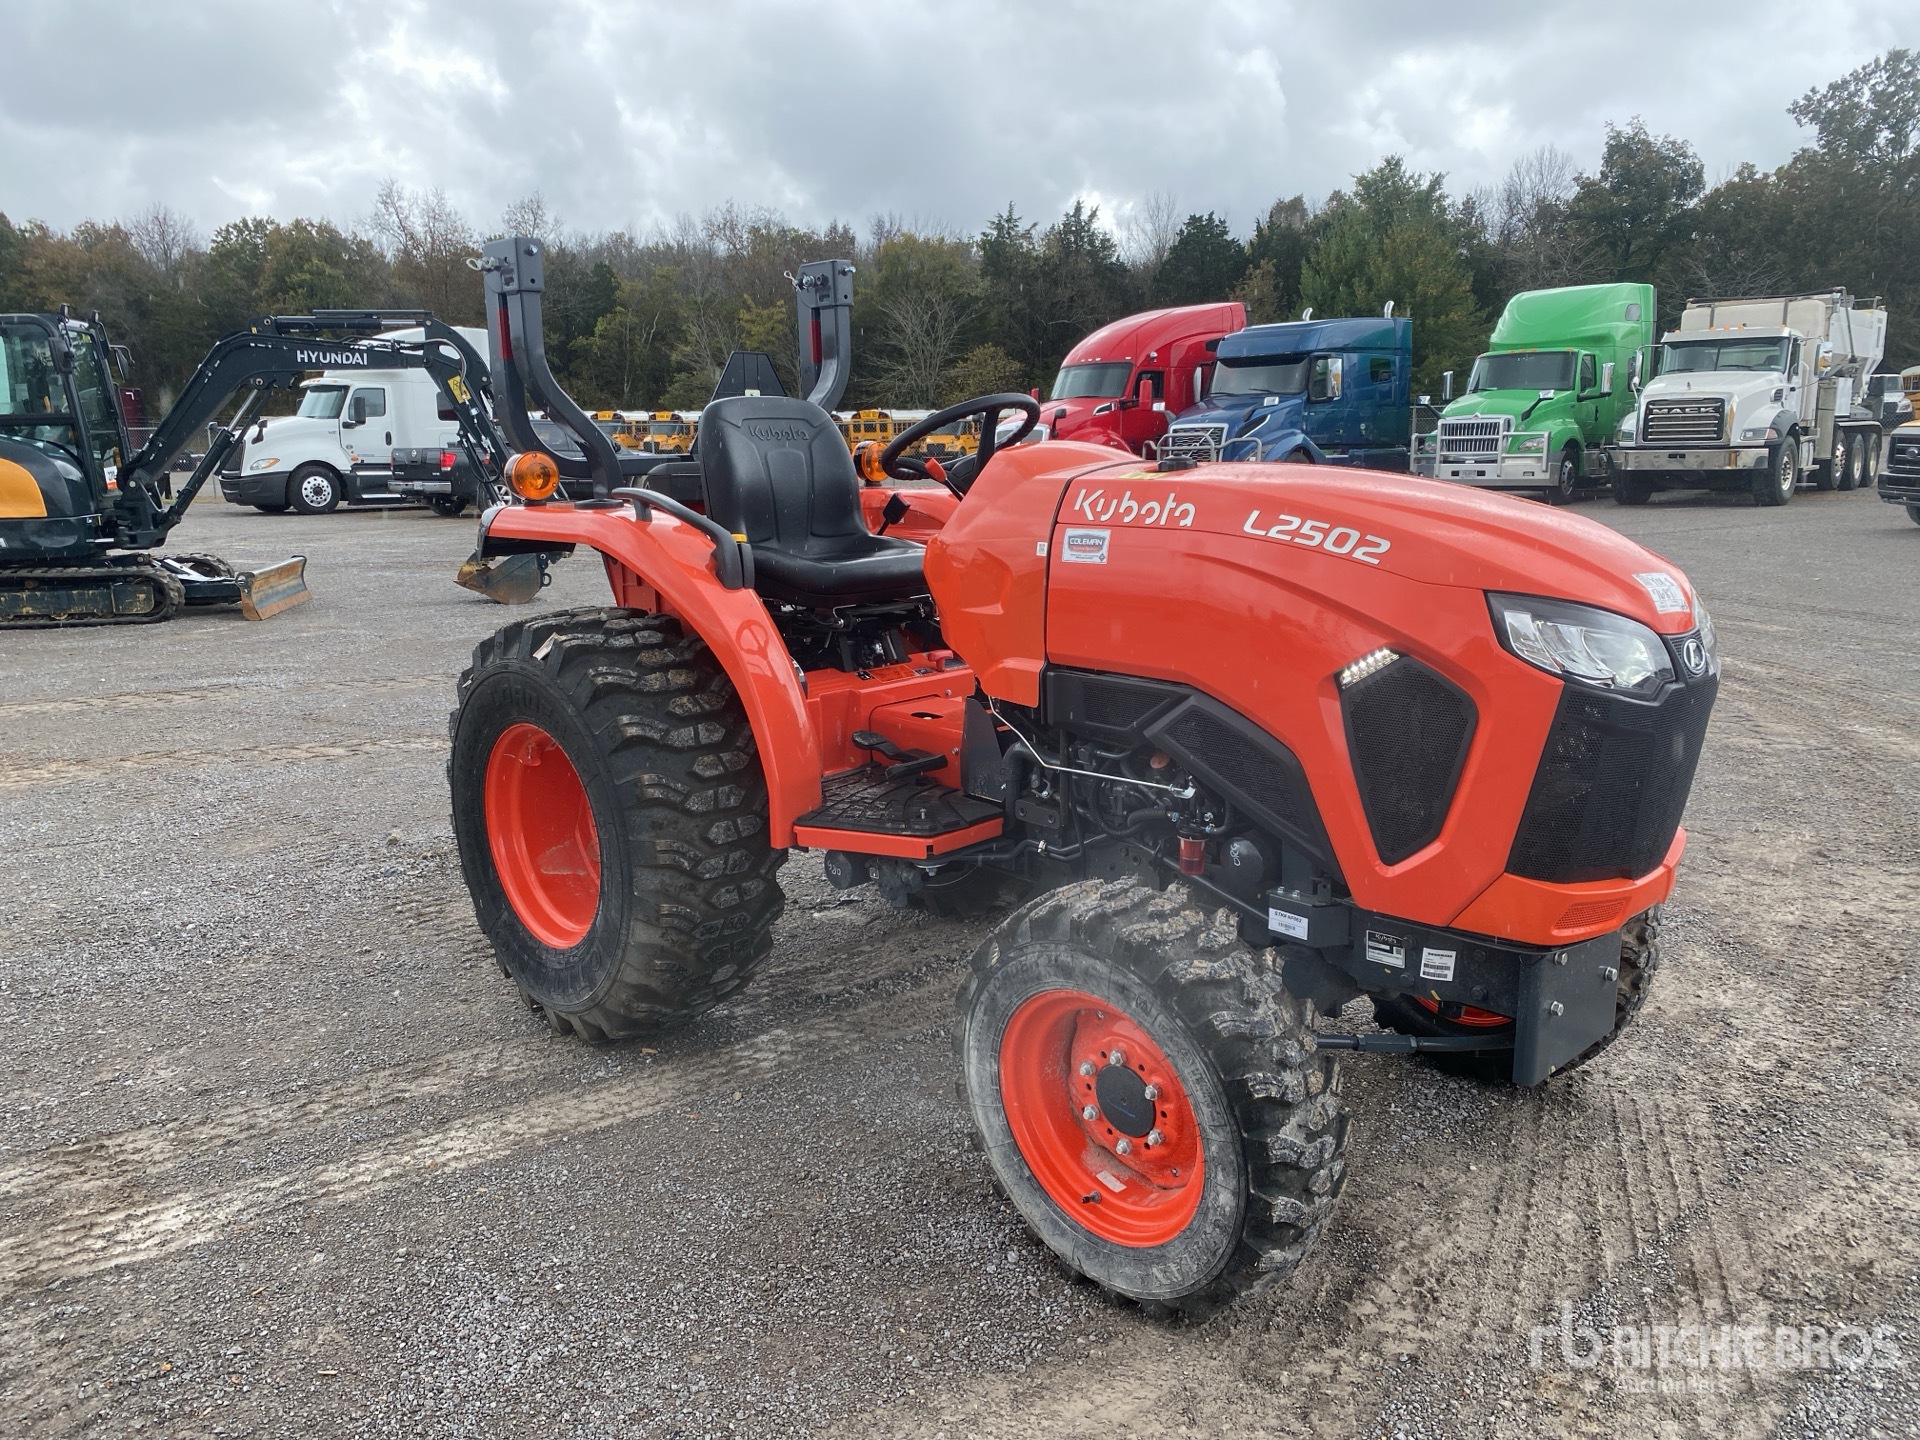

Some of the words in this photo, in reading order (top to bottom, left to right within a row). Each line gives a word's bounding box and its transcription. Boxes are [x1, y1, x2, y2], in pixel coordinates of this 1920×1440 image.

[296, 349, 368, 366] HYUNDAI
[1652, 407, 1716, 415] MACK
[748, 425, 810, 441] Kubota
[1073, 488, 1196, 527] Kubota
[1069, 537, 1103, 546] COLEMAN
[1243, 509, 1391, 565] L2502
[1375, 933, 1397, 944] Kubota
